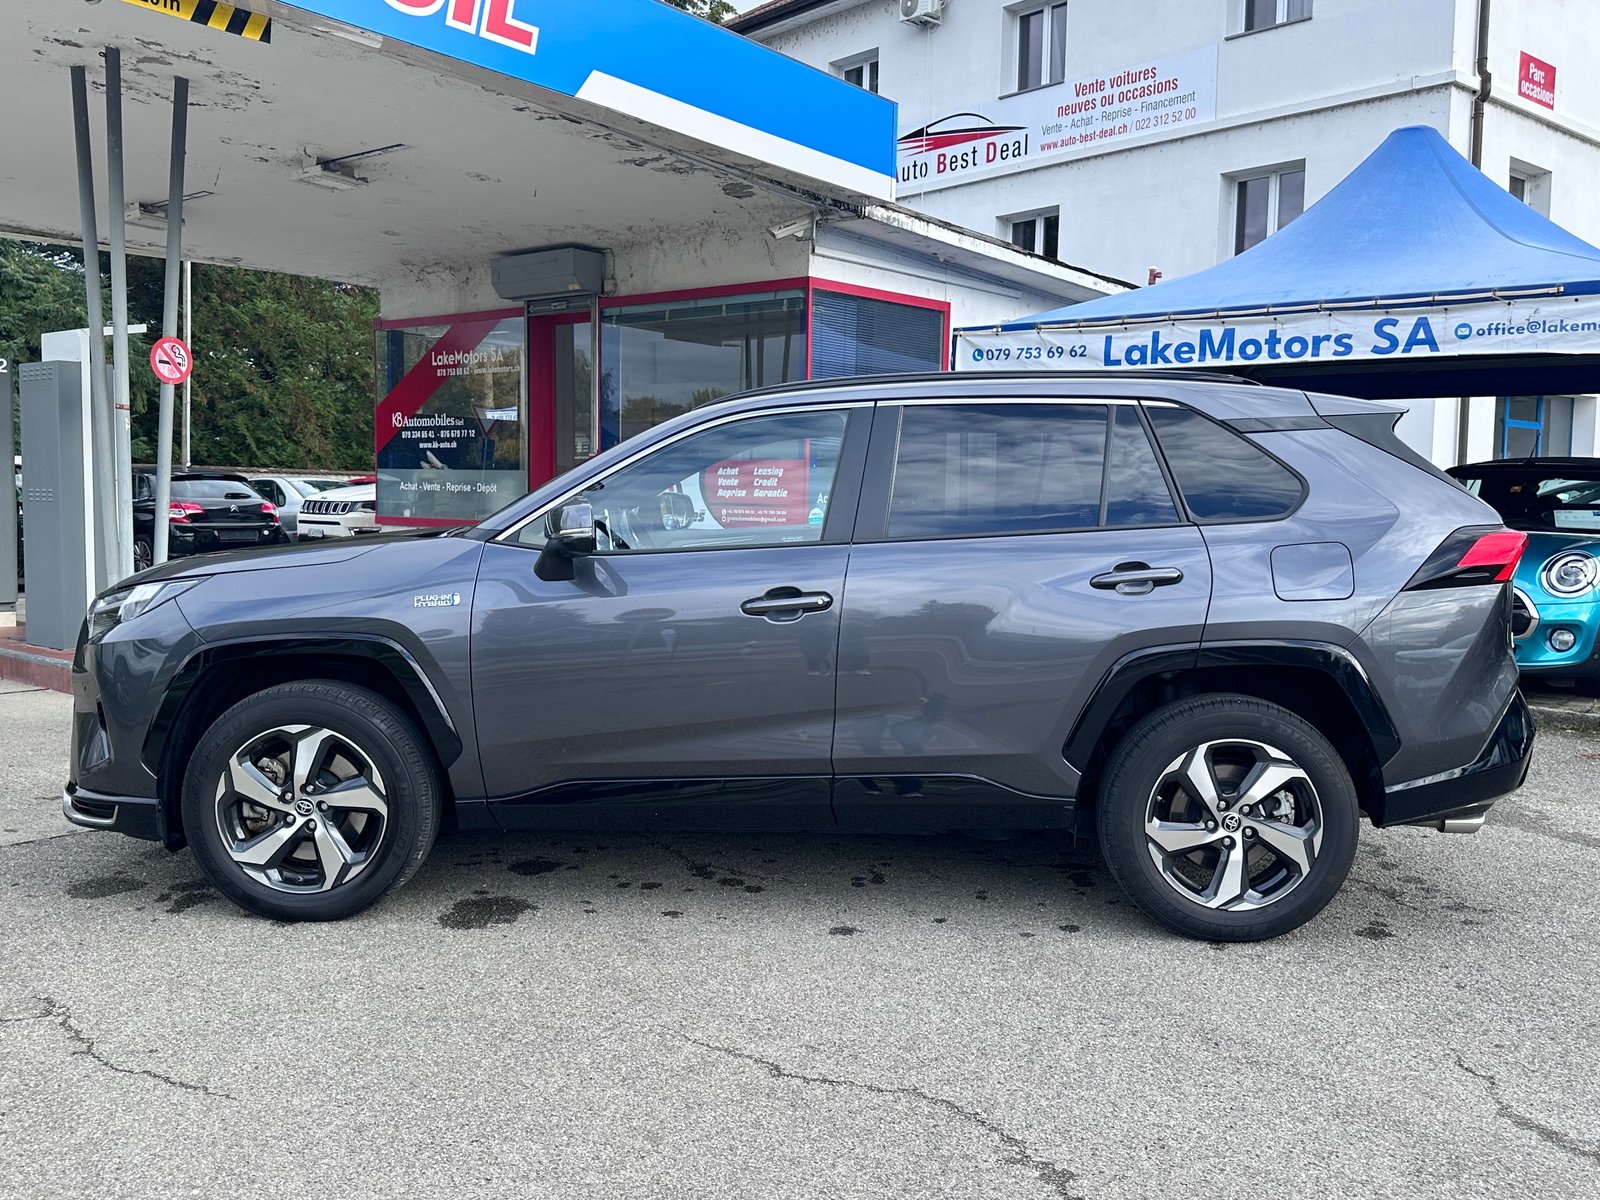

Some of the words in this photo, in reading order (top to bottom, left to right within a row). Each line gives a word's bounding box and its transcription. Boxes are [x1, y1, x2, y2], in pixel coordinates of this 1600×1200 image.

[1529, 62, 1545, 84] Parc
[1074, 78, 1105, 98] Vente
[1109, 66, 1157, 89] voitures
[1057, 98, 1097, 118] neuves
[1100, 94, 1114, 107] ou
[1118, 78, 1178, 103] occasions
[1520, 80, 1554, 105] occasions
[1041, 123, 1063, 136] Vente
[1070, 115, 1094, 129] Achat
[1101, 107, 1132, 122] Reprise
[1140, 90, 1196, 113] Financement
[1040, 123, 1128, 152] www.auto-best-deal.ch
[1135, 117, 1151, 131] 022
[1153, 113, 1169, 127] 312
[1171, 110, 1183, 123] 52
[1185, 107, 1196, 120] 00
[896, 160, 928, 183] uto
[937, 146, 978, 174] Best
[986, 133, 1028, 163] Deal
[1476, 319, 1600, 336] office@lakem
[1103, 327, 1354, 367] LakeMotors
[1370, 316, 1441, 355] SA
[431, 349, 487, 366] LakeMotors
[490, 346, 503, 361] SA
[985, 348, 1011, 361] 079
[1016, 347, 1042, 360] 753
[1046, 345, 1064, 359] 69
[1069, 345, 1087, 358] 62
[403, 413, 455, 427] Automobiles
[461, 429, 468, 437] 77
[468, 429, 475, 437] 12
[717, 467, 739, 475] Achat
[753, 467, 784, 477] Leasing
[399, 481, 418, 491] Achat
[422, 482, 441, 491] Vente
[446, 482, 471, 493] Reprise
[717, 477, 739, 486] Vente
[717, 488, 747, 498] Reprise
[753, 488, 788, 497] Garantie
[414, 593, 450, 601] PLUG-IN
[414, 600, 452, 608] HYBRID
